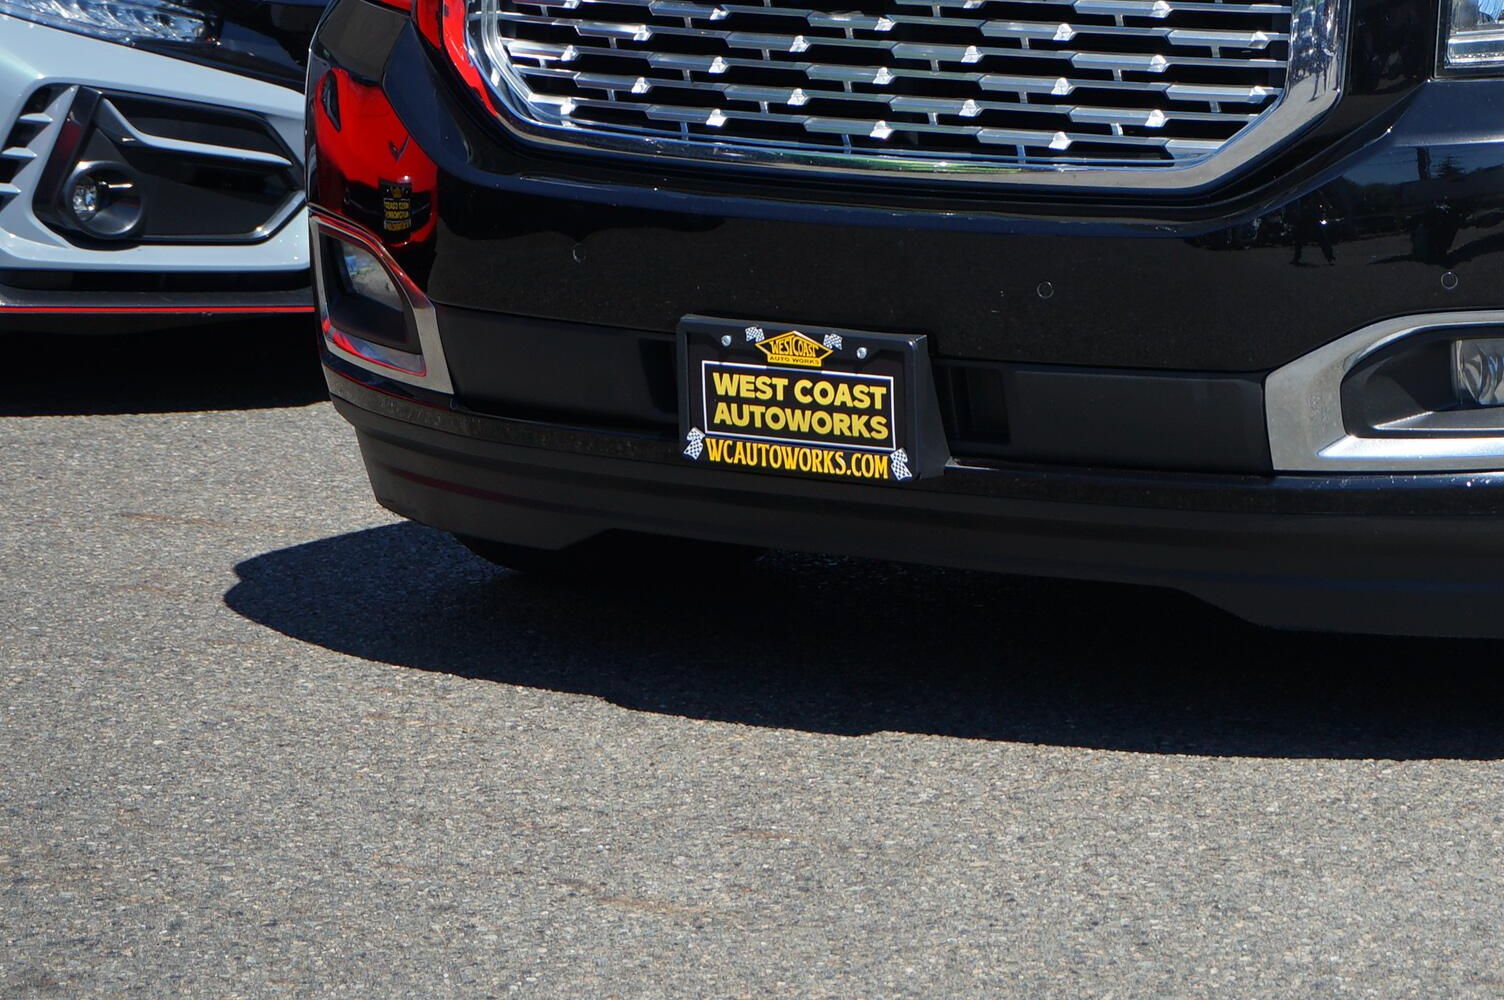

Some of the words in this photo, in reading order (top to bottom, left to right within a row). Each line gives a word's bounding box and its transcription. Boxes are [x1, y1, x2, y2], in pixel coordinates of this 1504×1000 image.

[713, 372, 788, 401] WEST
[794, 379, 887, 410] COAST
[714, 402, 889, 440] AUTOWORKS
[705, 438, 889, 479] WCAUTOWORKS.COM
